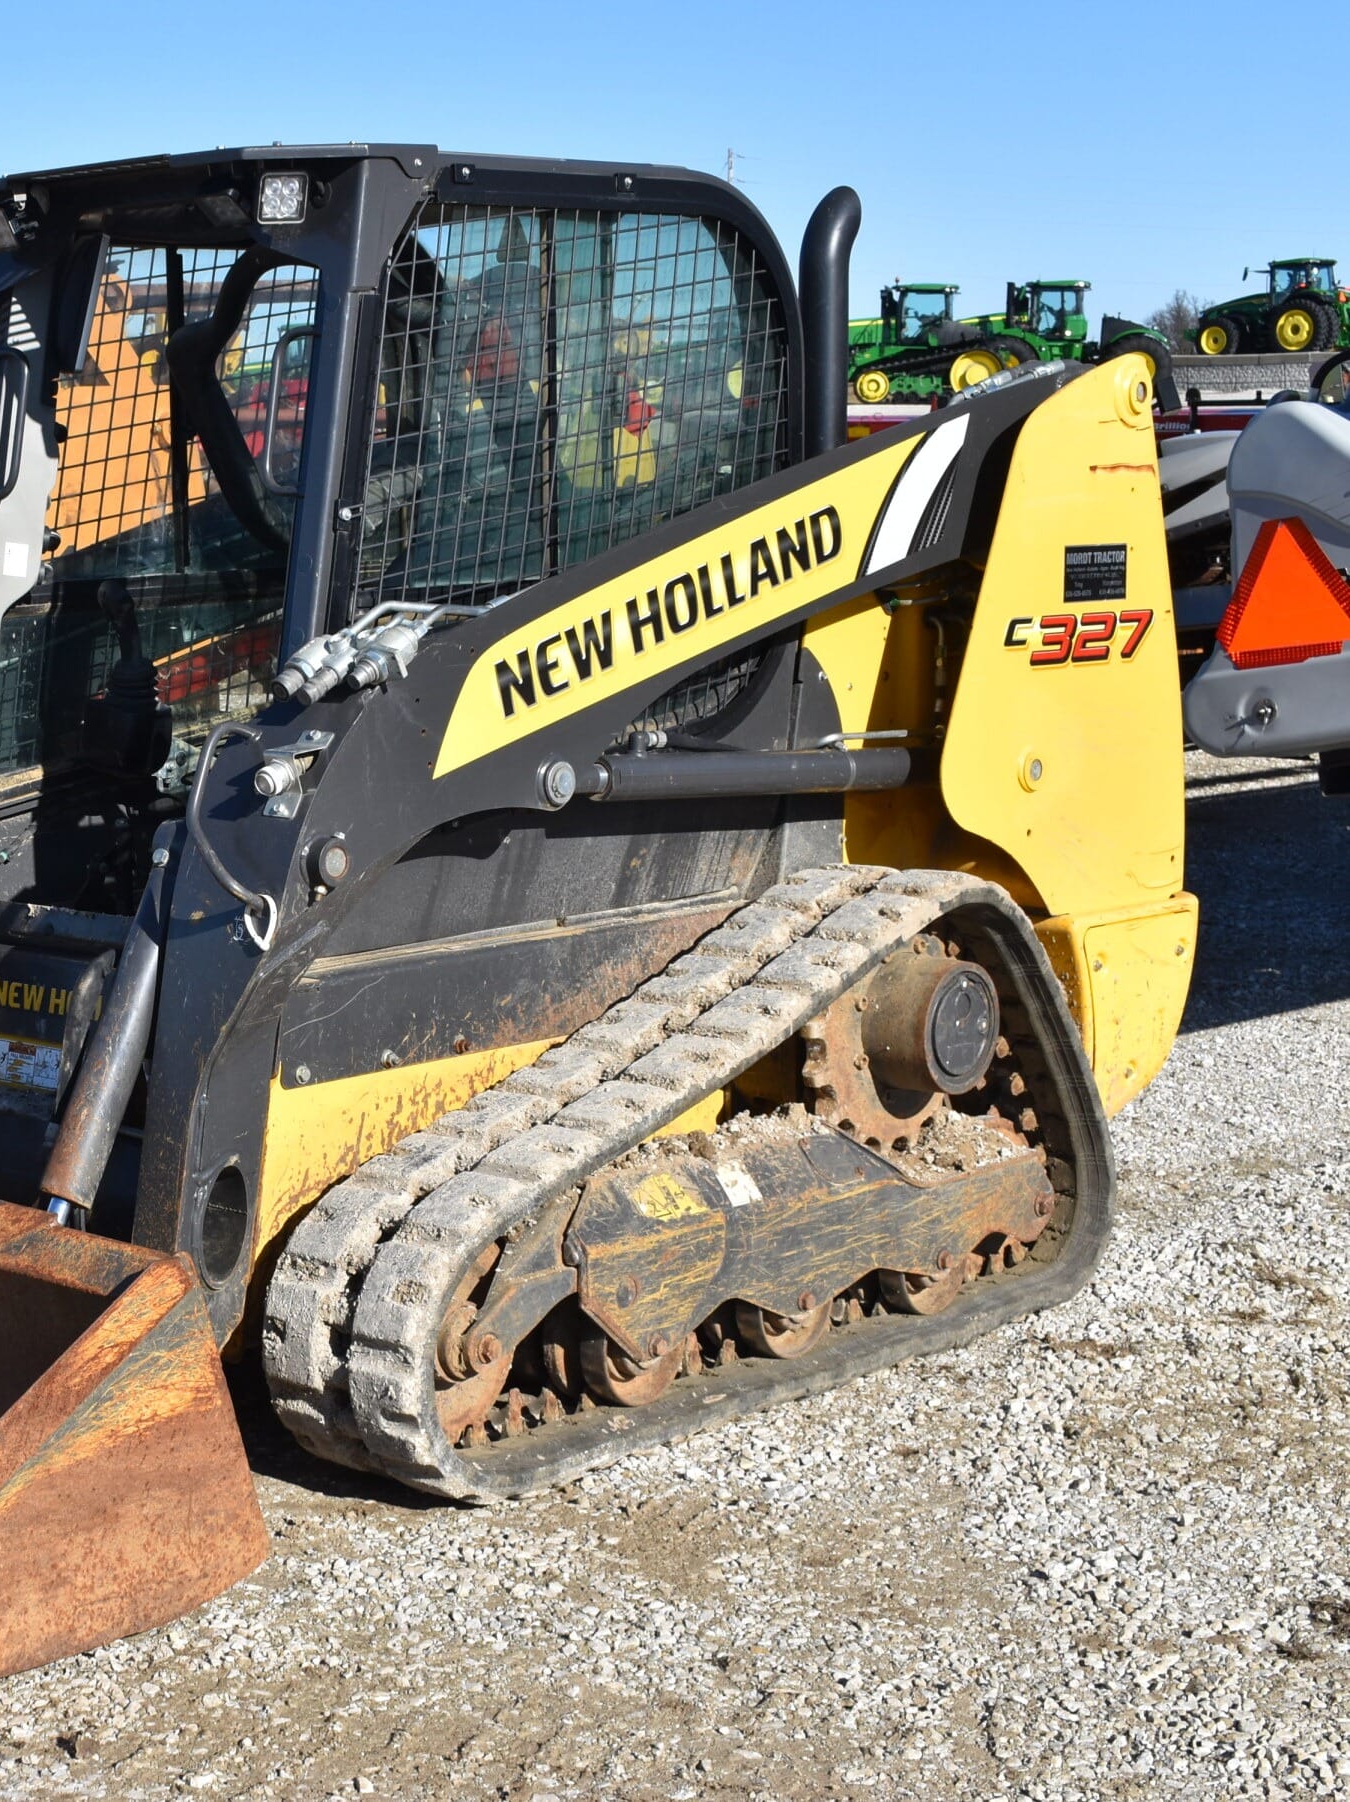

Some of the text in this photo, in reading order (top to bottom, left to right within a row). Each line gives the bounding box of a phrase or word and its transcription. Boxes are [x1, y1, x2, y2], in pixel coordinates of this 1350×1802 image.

[494, 505, 842, 717] NEW HOLLAND
[1093, 551, 1125, 563] TRACTOR
